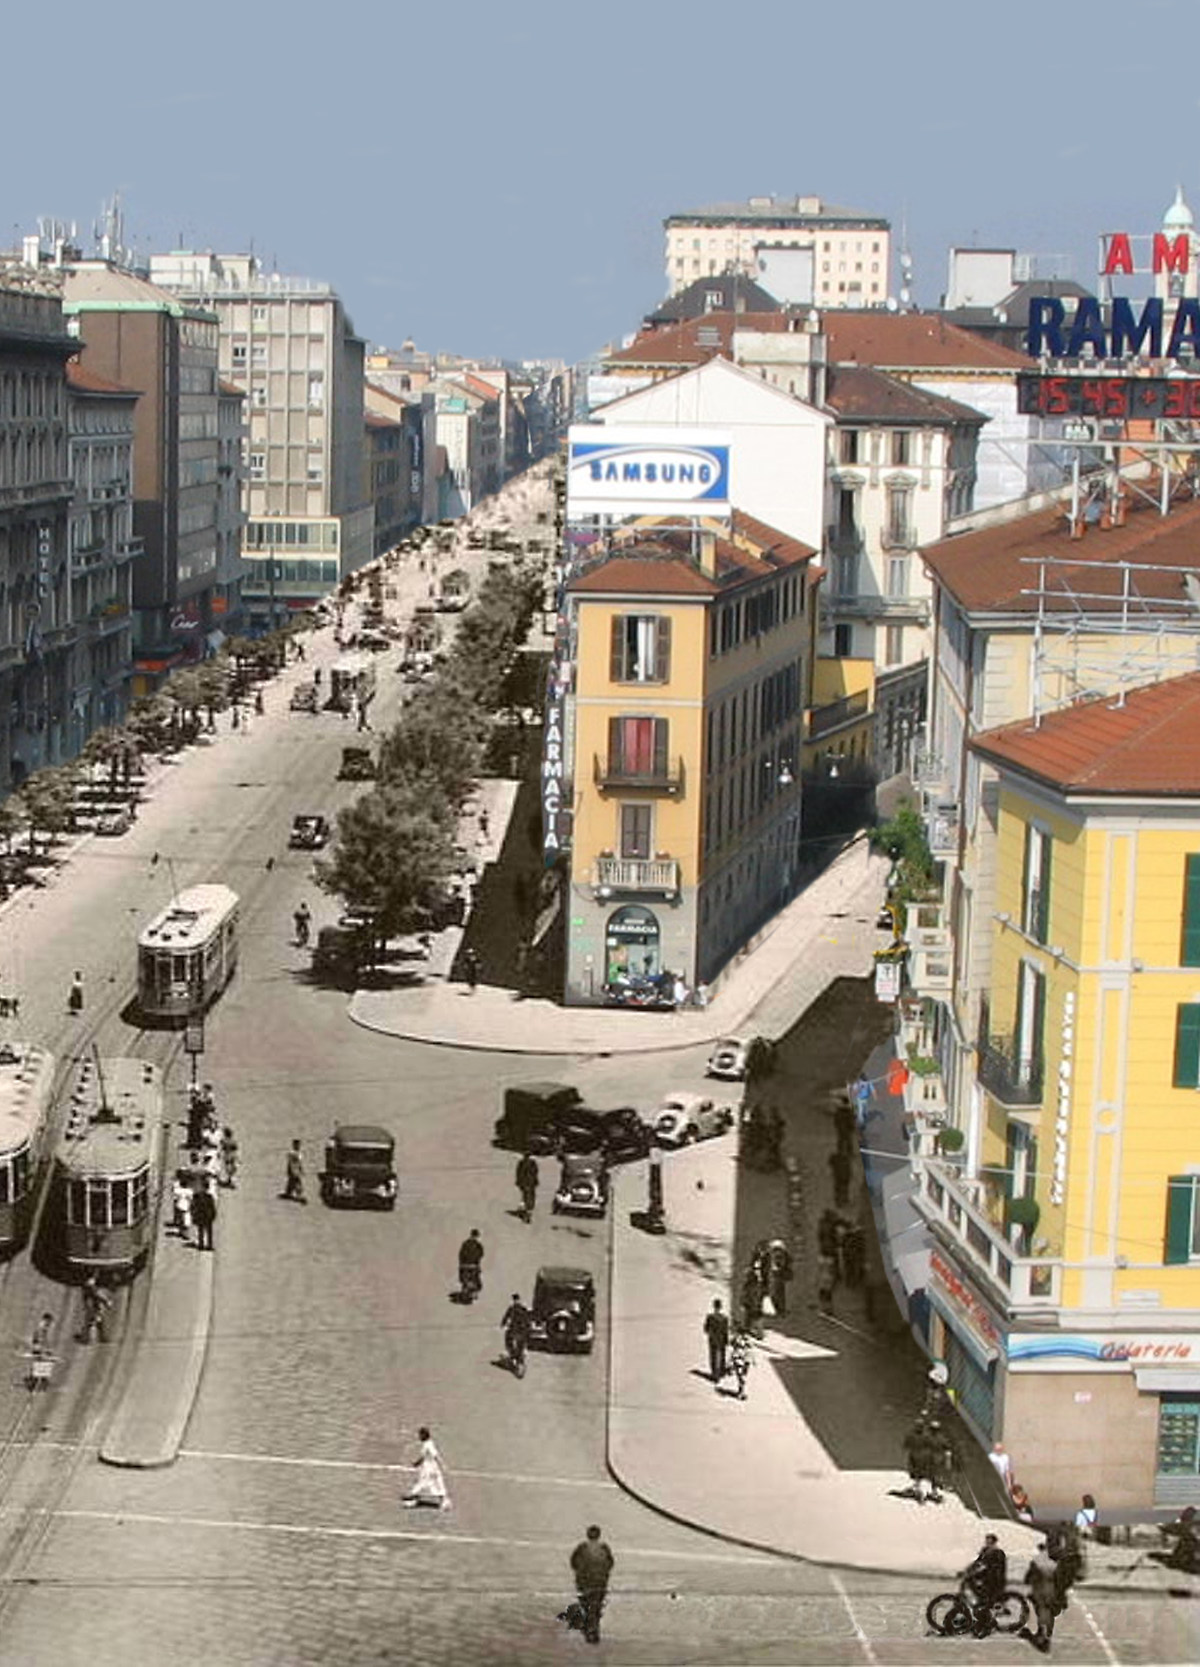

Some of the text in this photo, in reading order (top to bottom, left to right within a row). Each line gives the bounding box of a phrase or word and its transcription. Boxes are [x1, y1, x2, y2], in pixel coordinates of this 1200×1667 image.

[1028, 297, 1200, 358] RAMA
[590, 459, 711, 484] SAMSUNG
[39, 528, 49, 598] HOTEL
[544, 707, 562, 848] FARMACIA
[608, 923, 658, 934] FARMACIA
